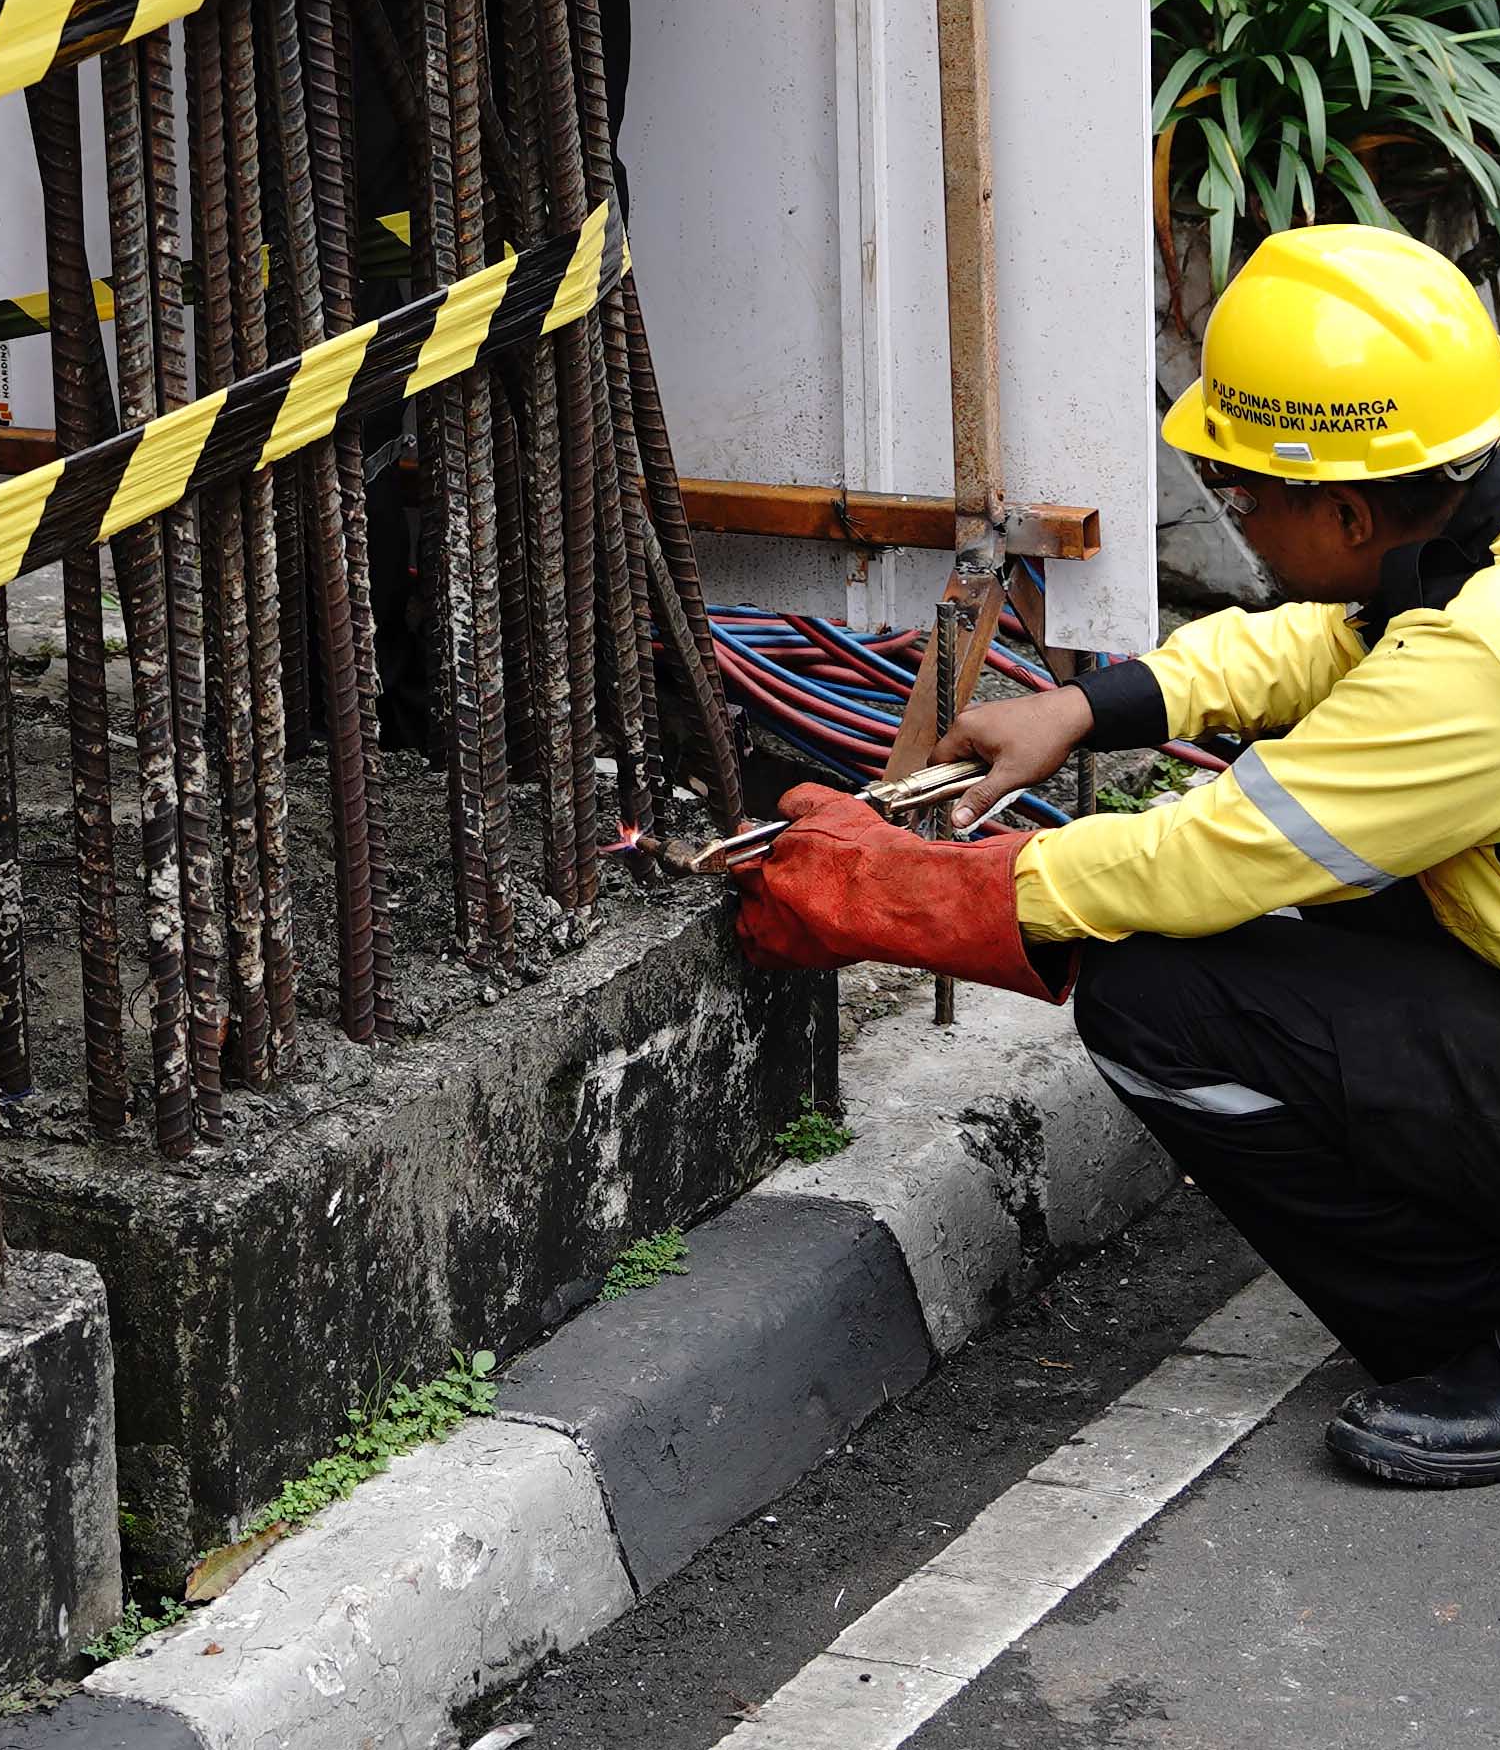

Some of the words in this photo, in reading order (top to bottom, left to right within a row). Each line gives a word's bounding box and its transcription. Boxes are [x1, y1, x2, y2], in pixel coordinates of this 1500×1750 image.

[1213, 378, 1236, 400] PJLP
[1239, 390, 1281, 413] DINAS
[1286, 400, 1326, 417] BINA
[1331, 398, 1399, 417] MARGA
[1220, 399, 1276, 428] PROVINSI
[1280, 415, 1305, 431] DKI
[1310, 417, 1388, 433] JAKARTA
